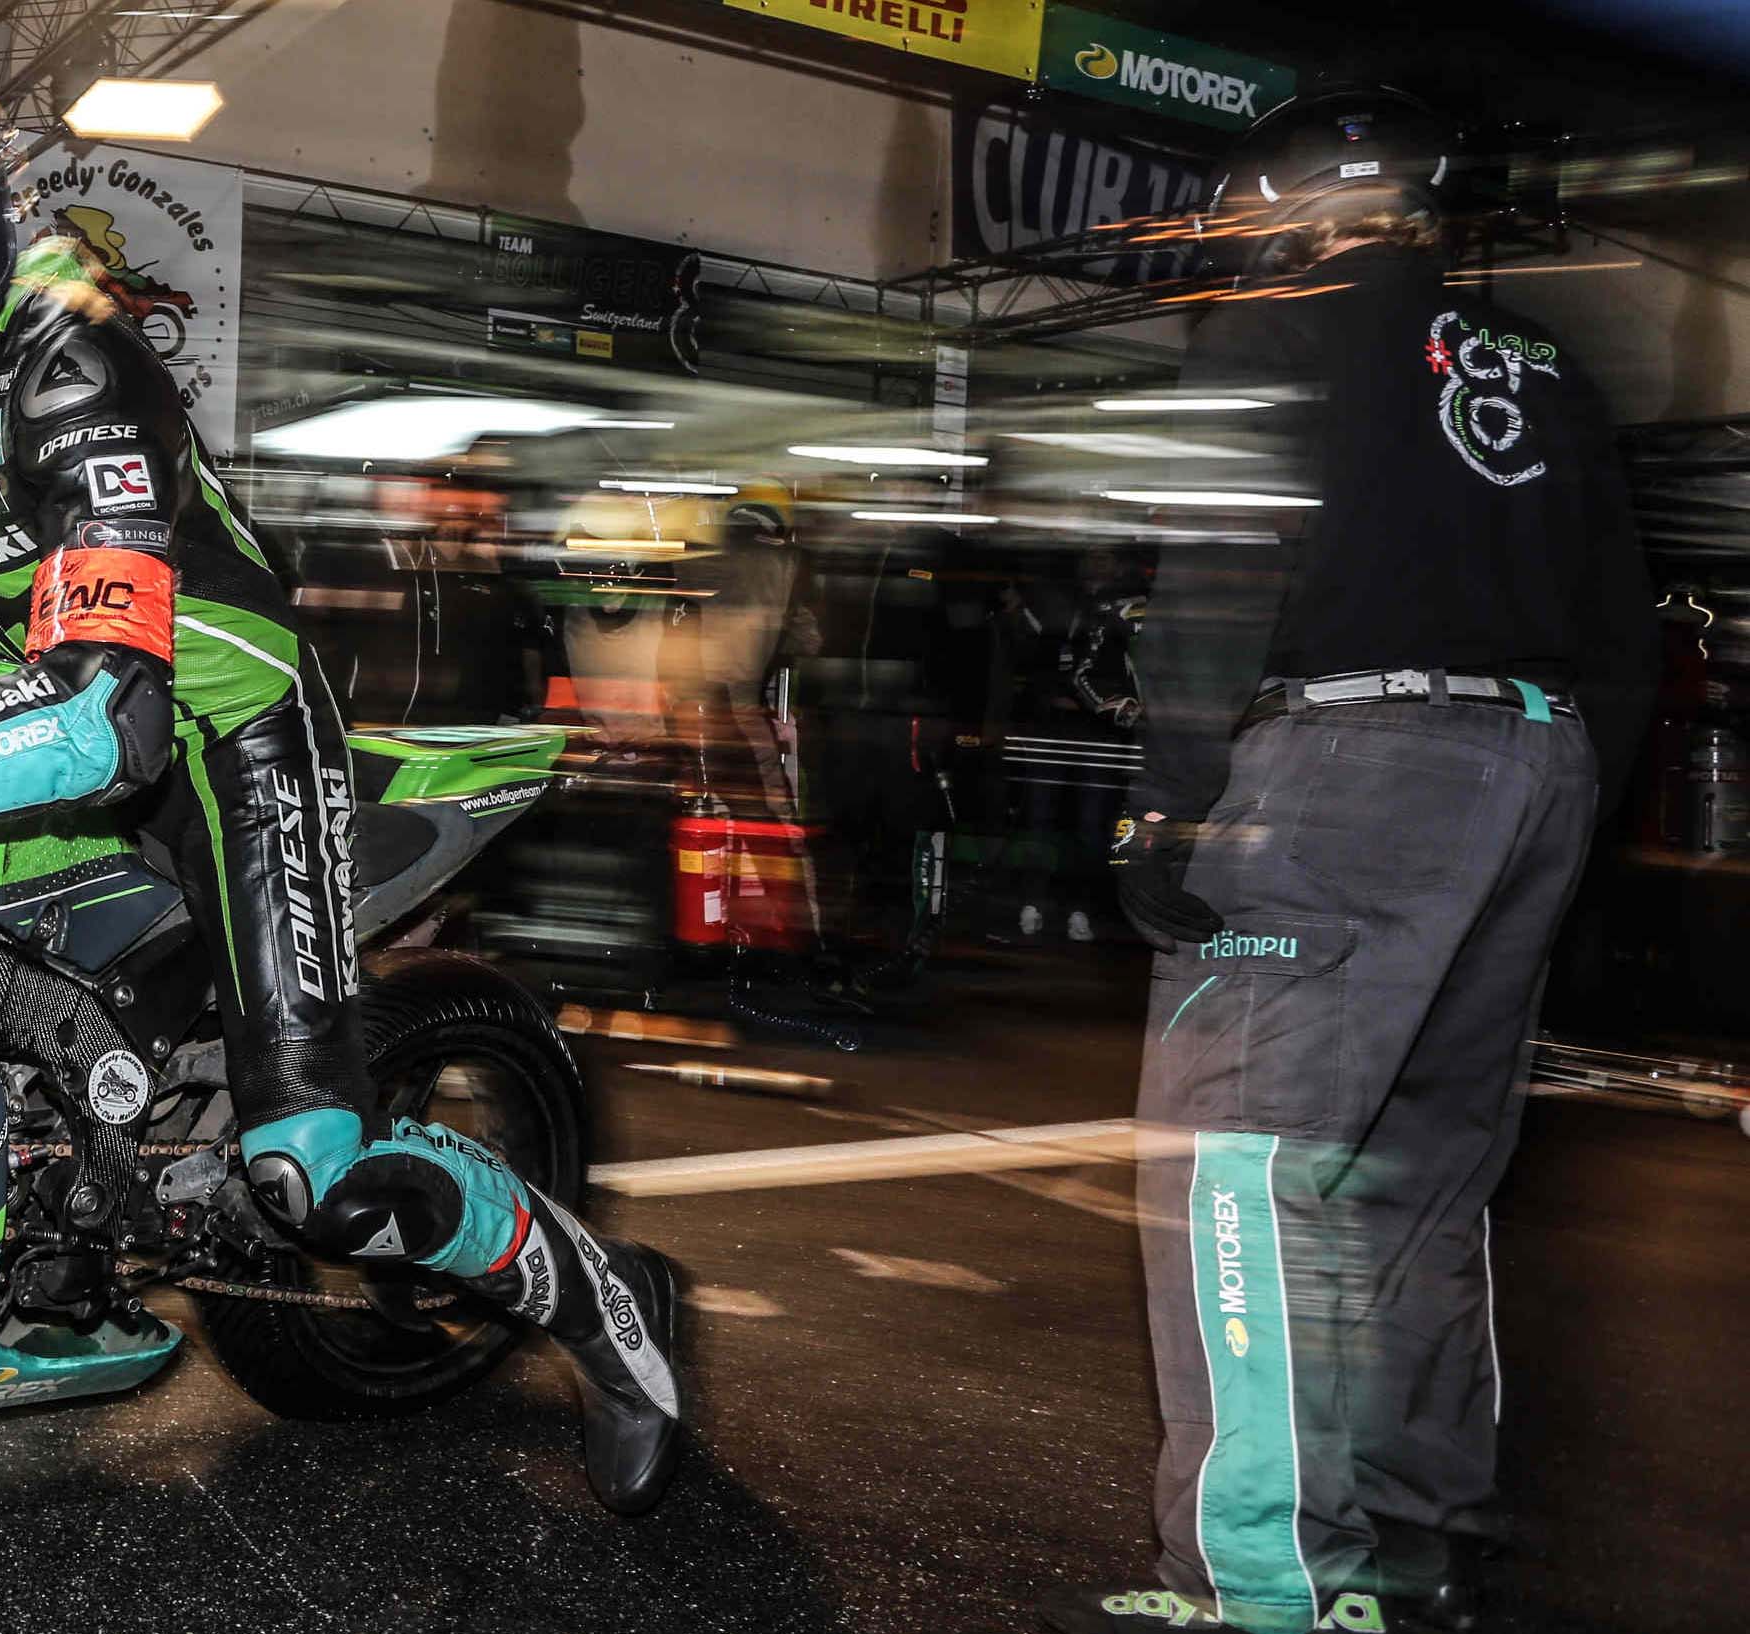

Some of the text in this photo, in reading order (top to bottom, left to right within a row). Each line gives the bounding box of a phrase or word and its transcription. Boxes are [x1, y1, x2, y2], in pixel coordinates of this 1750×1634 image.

[1119, 49, 1258, 118] MOTOREX
[107, 159, 214, 252] Gonzales
[973, 106, 1132, 274] CLUB
[499, 235, 533, 254] TEAM
[580, 303, 664, 331] Switzerland
[38, 424, 139, 463] DAINESE
[38, 577, 135, 620] EWC
[272, 767, 325, 1002] DAINESE
[321, 767, 359, 996] Kawasaki
[1211, 1190, 1247, 1314] MOTOREX
